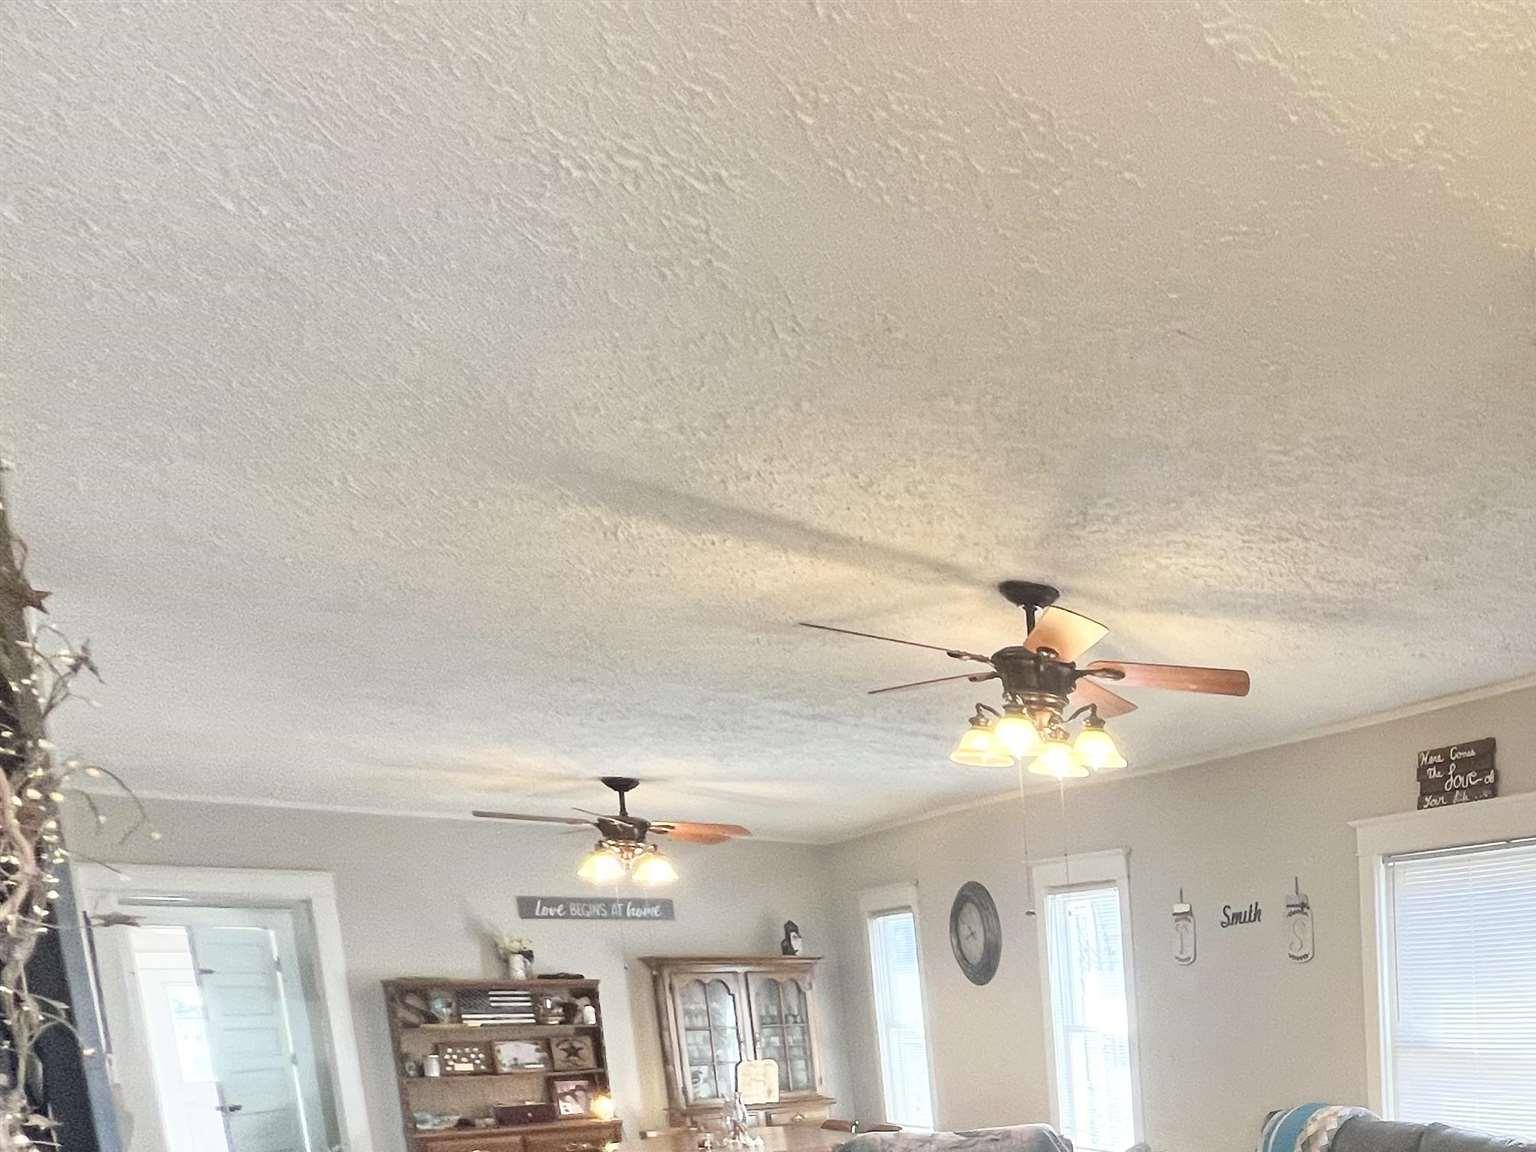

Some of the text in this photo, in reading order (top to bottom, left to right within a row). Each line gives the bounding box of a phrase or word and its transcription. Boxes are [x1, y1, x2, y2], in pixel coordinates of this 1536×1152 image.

[1444, 763, 1482, 791] Love
[535, 900, 567, 916] Love
[569, 902, 608, 917] BEGINS
[611, 903, 624, 916] AT
[1220, 901, 1262, 928] Smith
